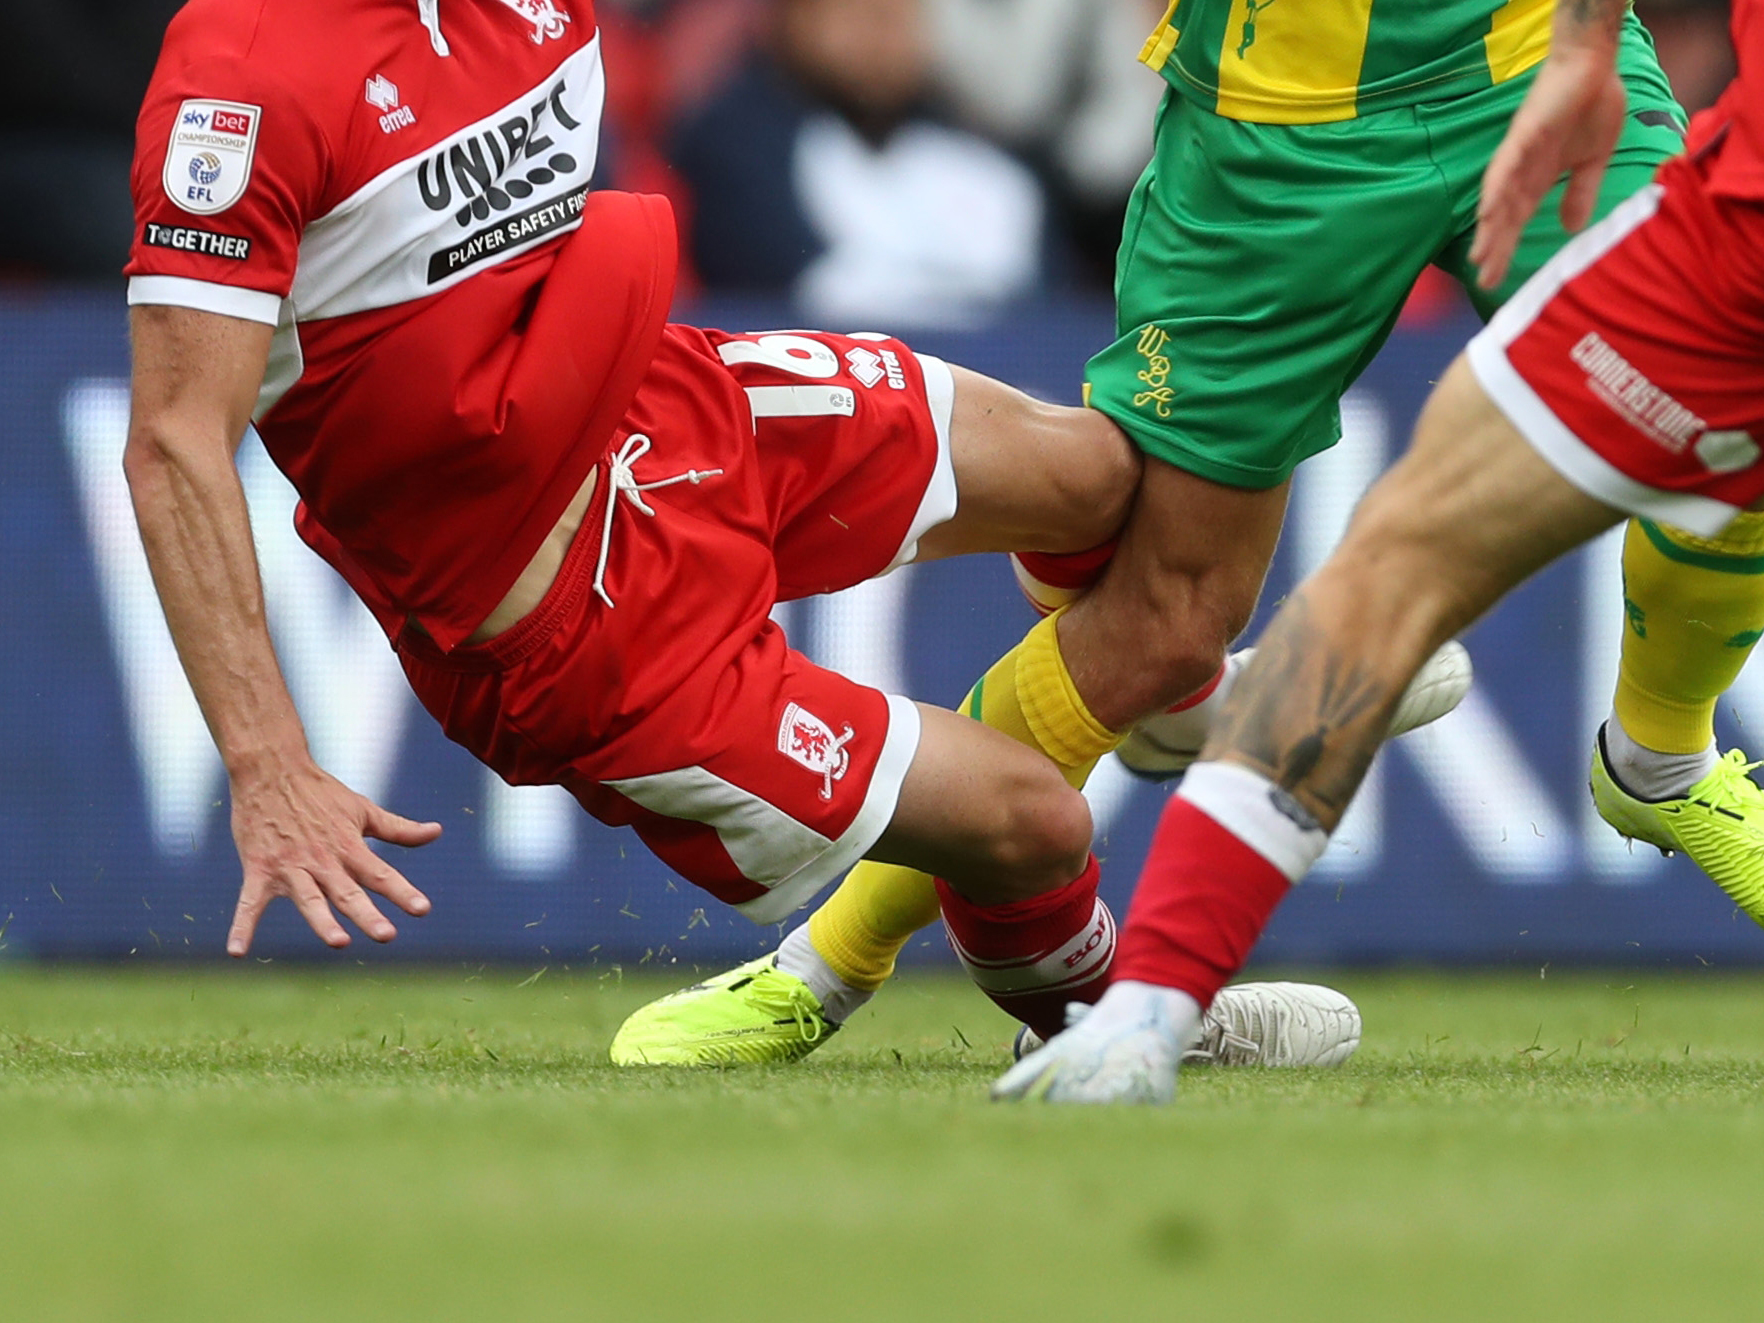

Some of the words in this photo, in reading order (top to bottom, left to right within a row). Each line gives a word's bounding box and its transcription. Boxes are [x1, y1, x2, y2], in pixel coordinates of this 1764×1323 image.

[177, 131, 247, 149] CHAMPIONSHIP
[182, 109, 210, 128] sky
[214, 111, 248, 132] bet
[416, 78, 581, 211] UNIBET
[187, 184, 214, 203] EFL
[448, 232, 507, 267] PLAYER
[507, 202, 566, 240] SAFETY
[717, 334, 856, 436] 16
[1569, 330, 1708, 443] CORNERSTONE
